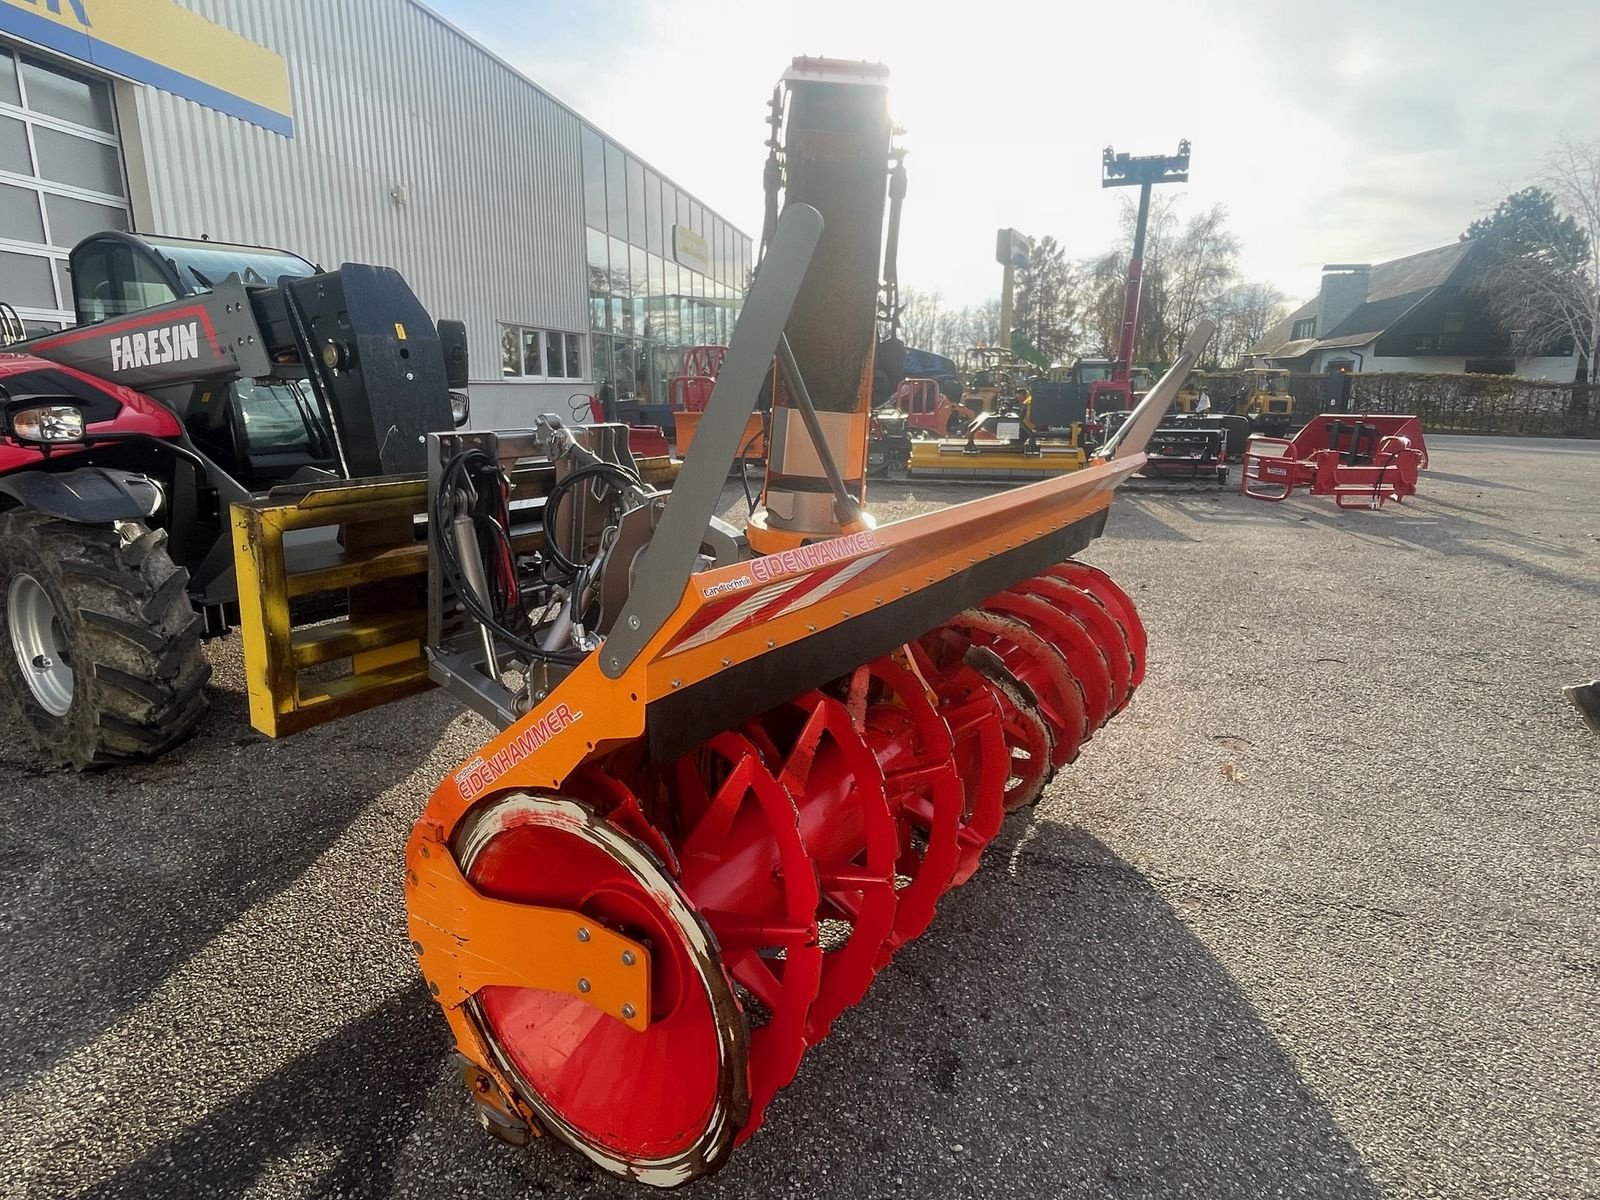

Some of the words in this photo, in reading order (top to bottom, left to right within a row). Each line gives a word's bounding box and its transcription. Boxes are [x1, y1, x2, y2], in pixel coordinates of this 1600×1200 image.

[110, 322, 198, 372] FARESIN
[752, 531, 879, 582] EIDENHAMMER
[459, 703, 575, 800] EIDENHAMMER
